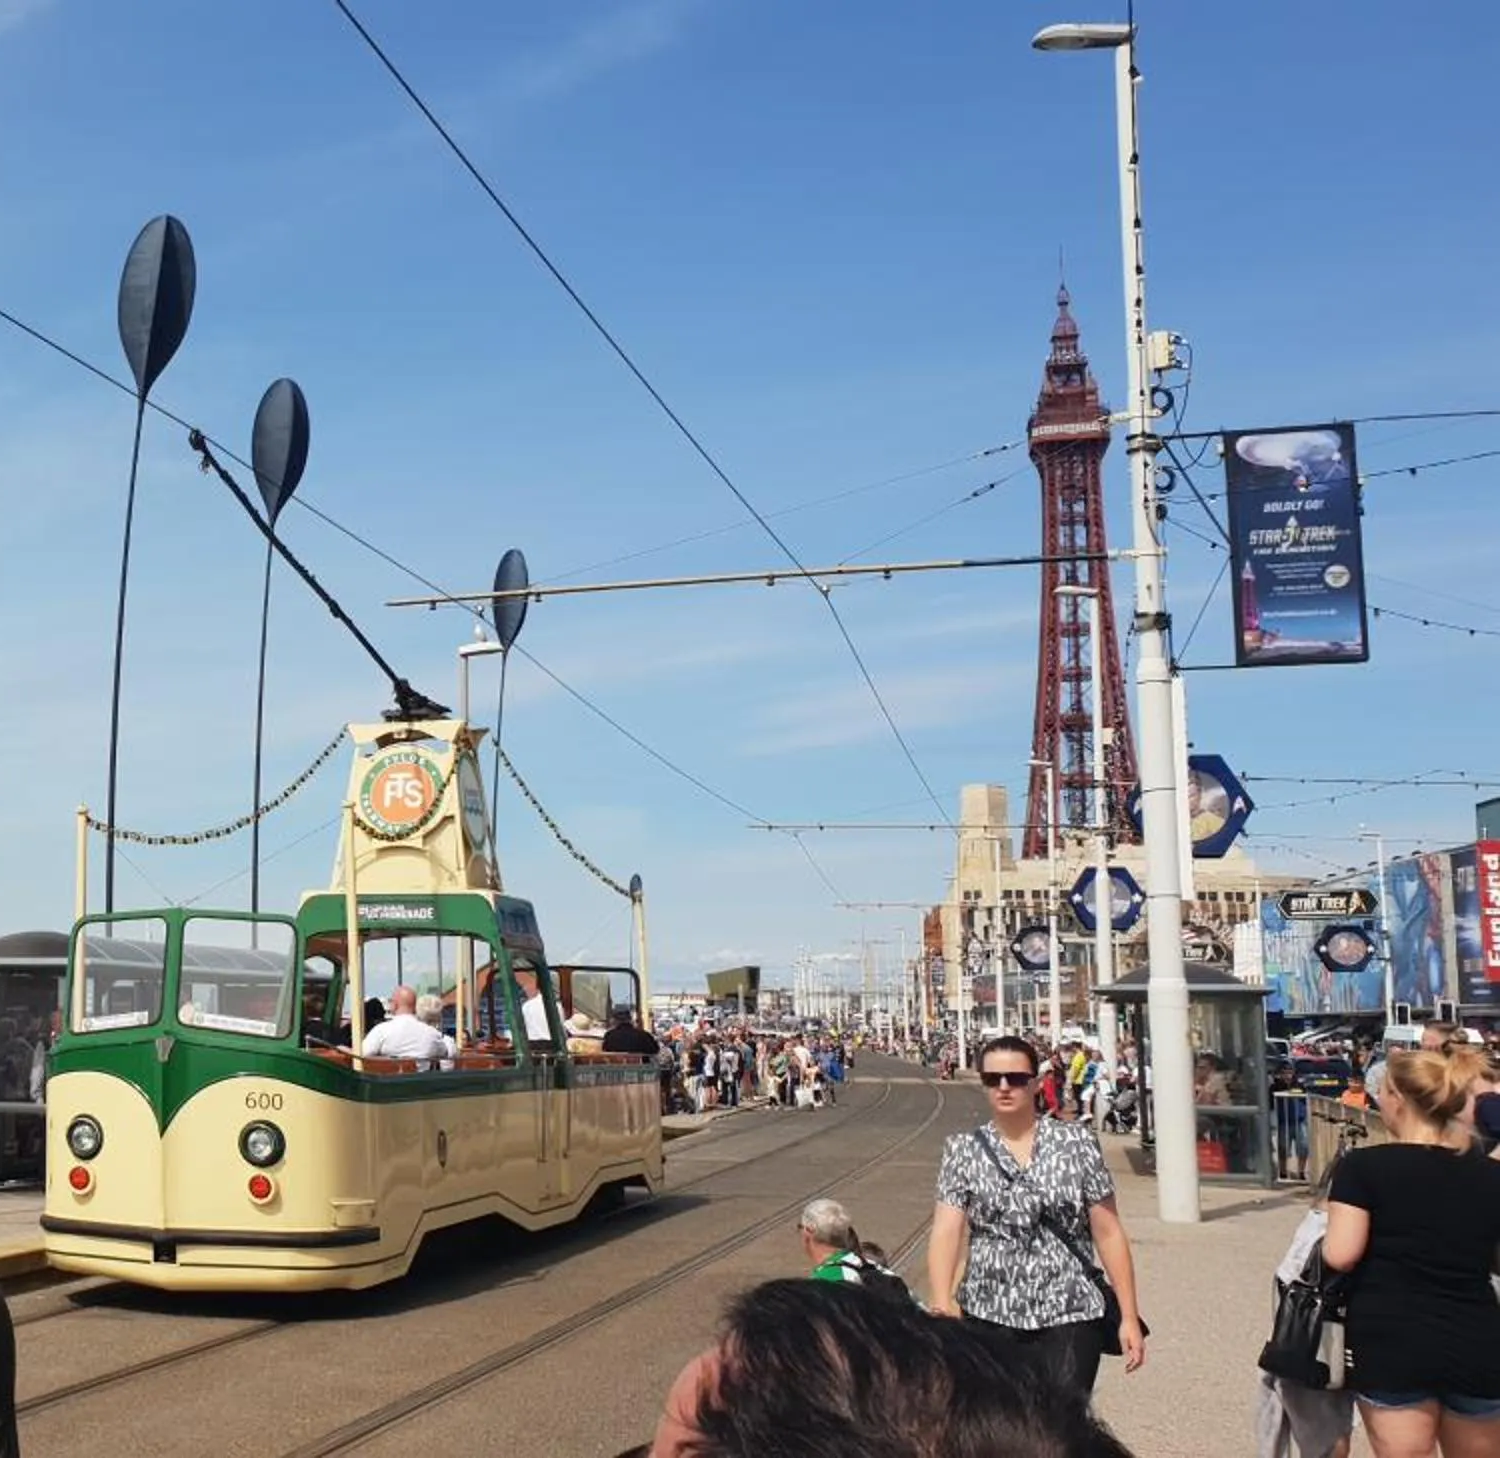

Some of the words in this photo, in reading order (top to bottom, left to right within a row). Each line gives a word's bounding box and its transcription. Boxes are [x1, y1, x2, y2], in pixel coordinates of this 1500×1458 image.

[1263, 500, 1303, 513] BOLDLY
[1249, 529, 1283, 545] STAR
[1300, 526, 1336, 542] TREK
[245, 1091, 283, 1111] 600
